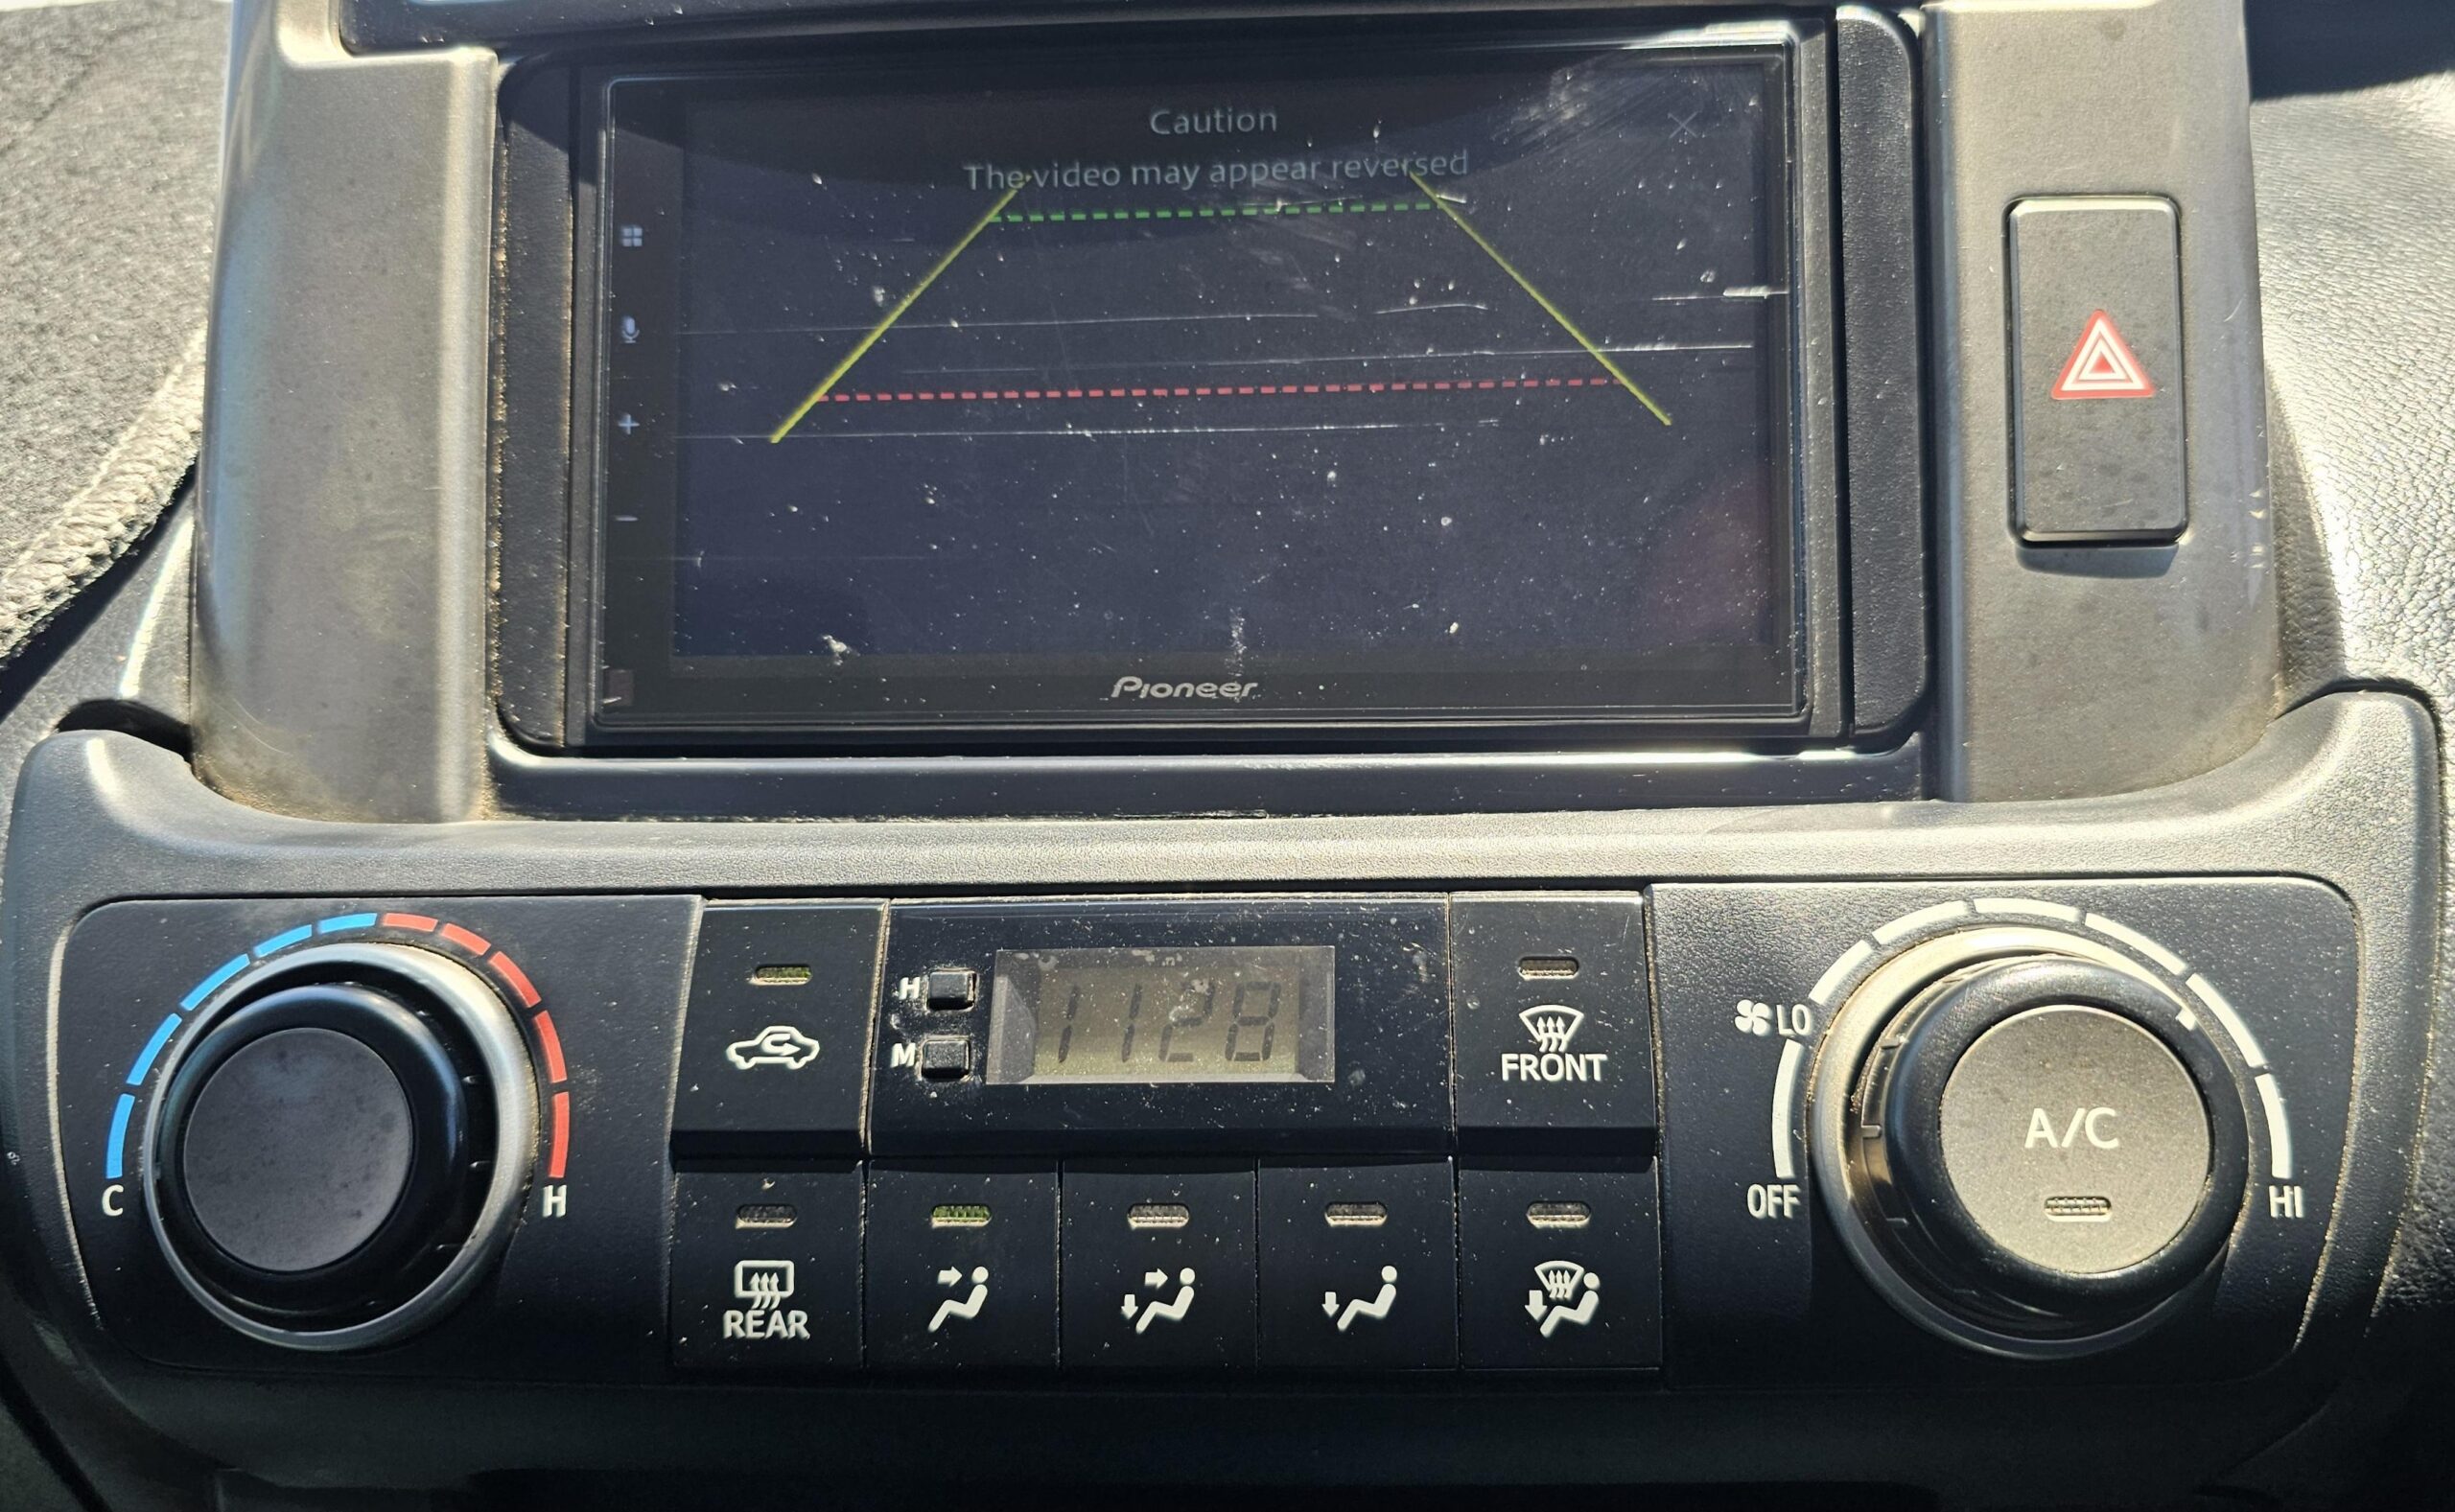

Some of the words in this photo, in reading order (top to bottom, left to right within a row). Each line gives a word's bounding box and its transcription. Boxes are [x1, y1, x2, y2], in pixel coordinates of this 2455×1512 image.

[1151, 107, 1277, 134] Caution
[963, 161, 1025, 190] The
[1033, 160, 1121, 189] video
[1132, 163, 1201, 191] may
[1209, 159, 1320, 187] appear
[1332, 148, 1468, 179] reversed
[1111, 675, 1259, 699] Pioneer
[899, 976, 921, 1000] H
[1776, 1003, 1812, 1036] LO
[890, 1042, 917, 1068] M
[1501, 1053, 1608, 1082] FRONT
[2023, 1106, 2120, 1150] A/C
[101, 1184, 125, 1217] C
[541, 1184, 568, 1219] H
[1746, 1184, 1801, 1219] OFF
[2268, 1185, 2304, 1219] HI
[722, 1309, 811, 1339] REAR
